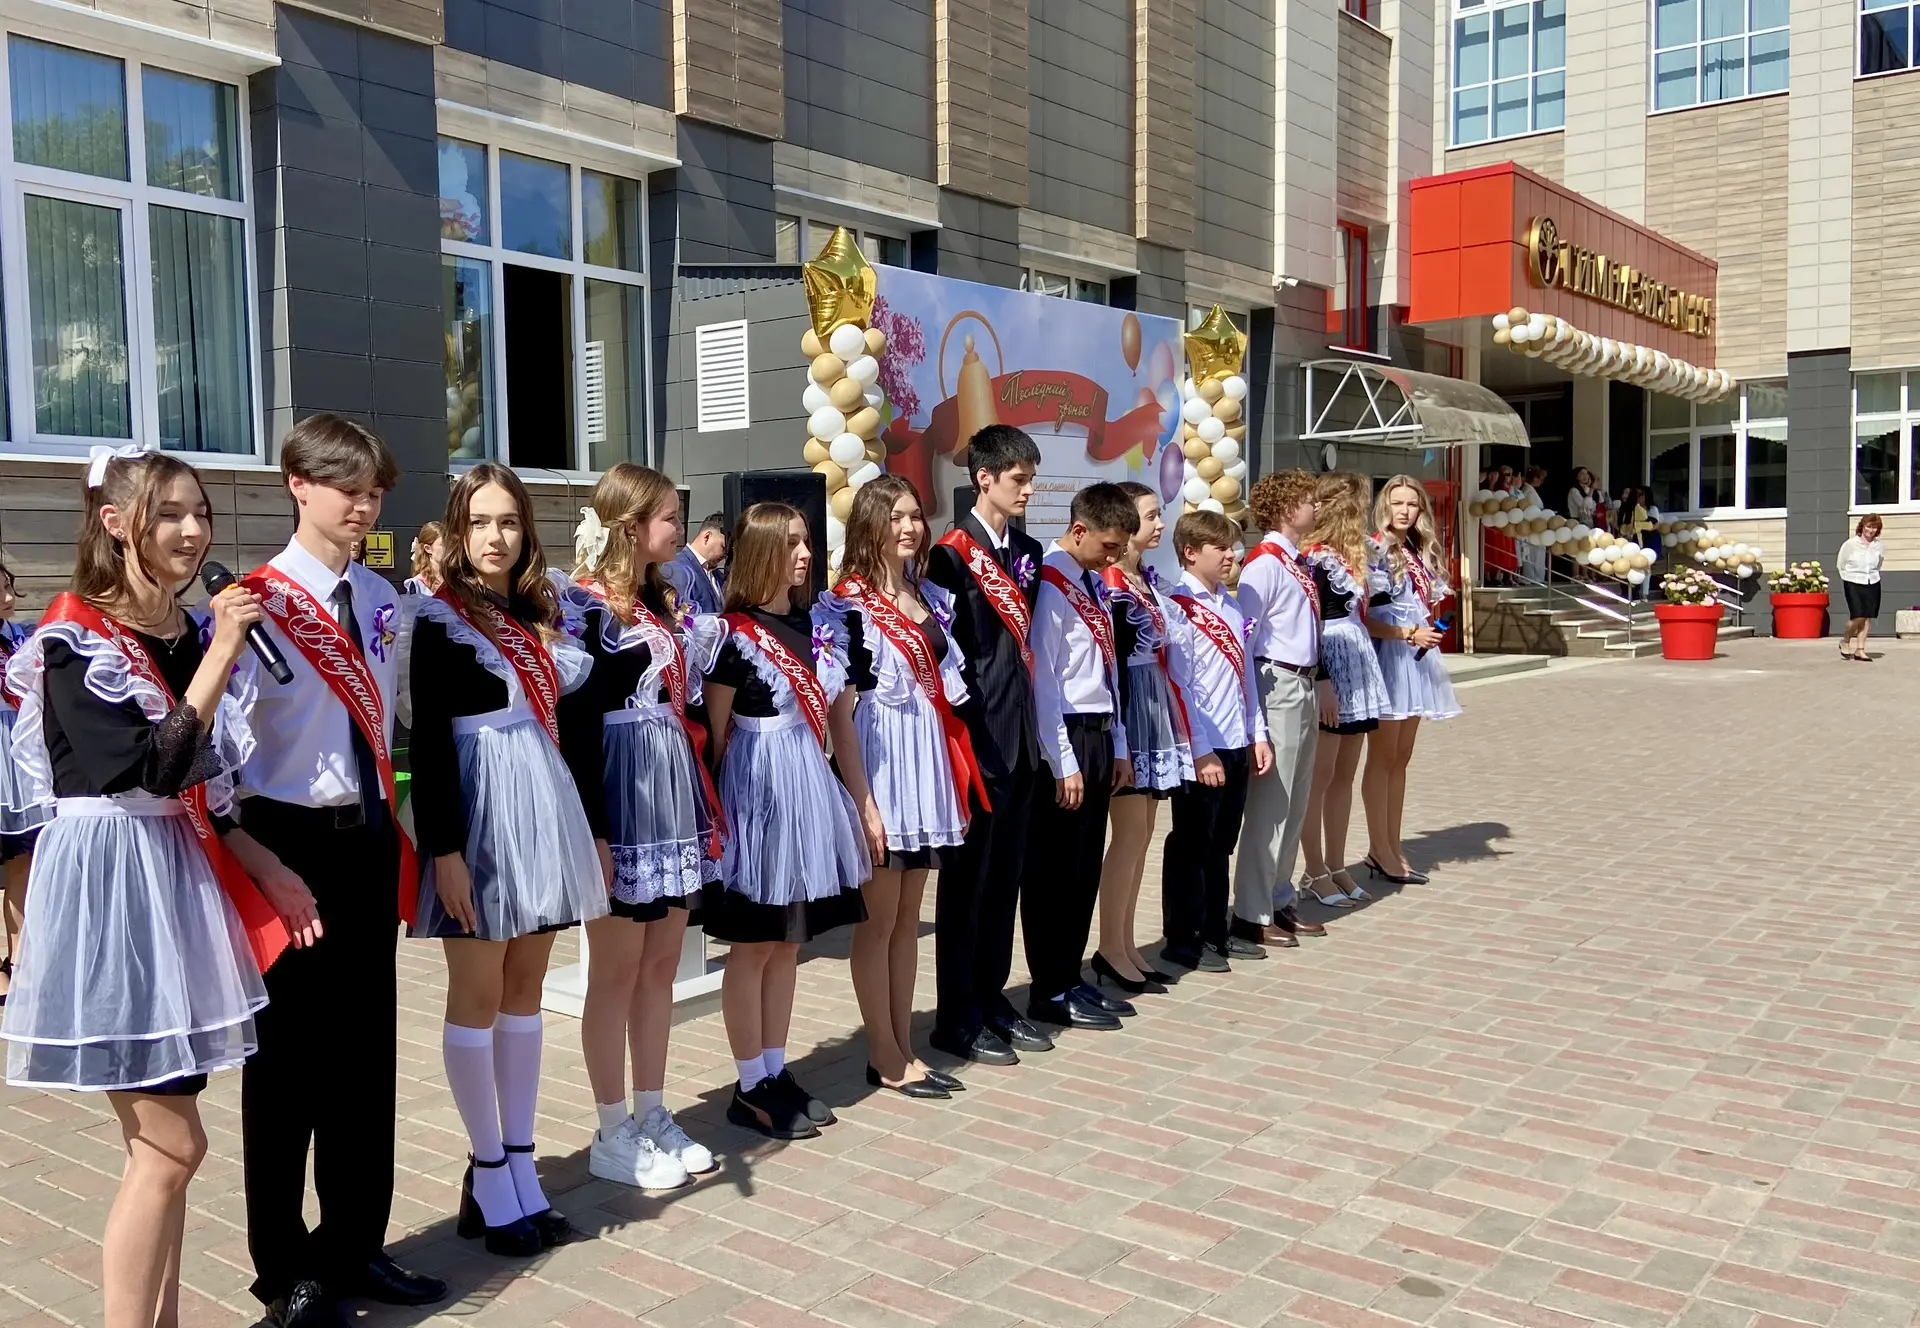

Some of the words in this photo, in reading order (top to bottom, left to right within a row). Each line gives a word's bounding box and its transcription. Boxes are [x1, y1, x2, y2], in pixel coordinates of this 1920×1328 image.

[1559, 239, 1670, 326] ГИМНАЗИЯ
[1001, 371, 1068, 409] Последний
[288, 613, 380, 722] Выпускник
[864, 601, 929, 672] Выпускник
